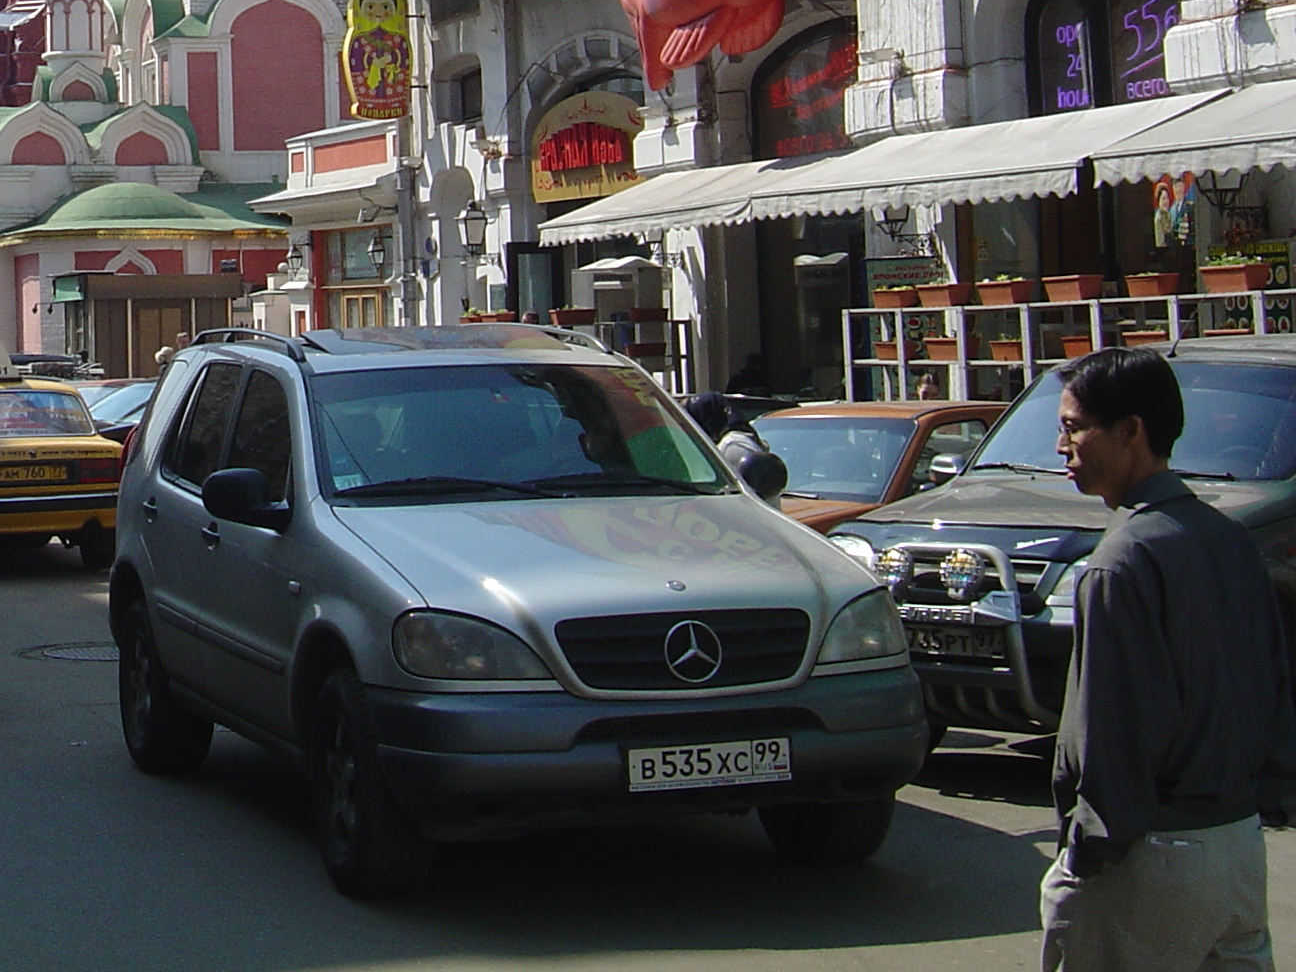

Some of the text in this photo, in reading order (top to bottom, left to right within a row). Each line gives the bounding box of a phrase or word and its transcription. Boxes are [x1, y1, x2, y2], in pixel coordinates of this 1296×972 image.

[1056, 25, 1080, 47] op
[24, 466, 46, 478] 760
[755, 741, 780, 762] 99
